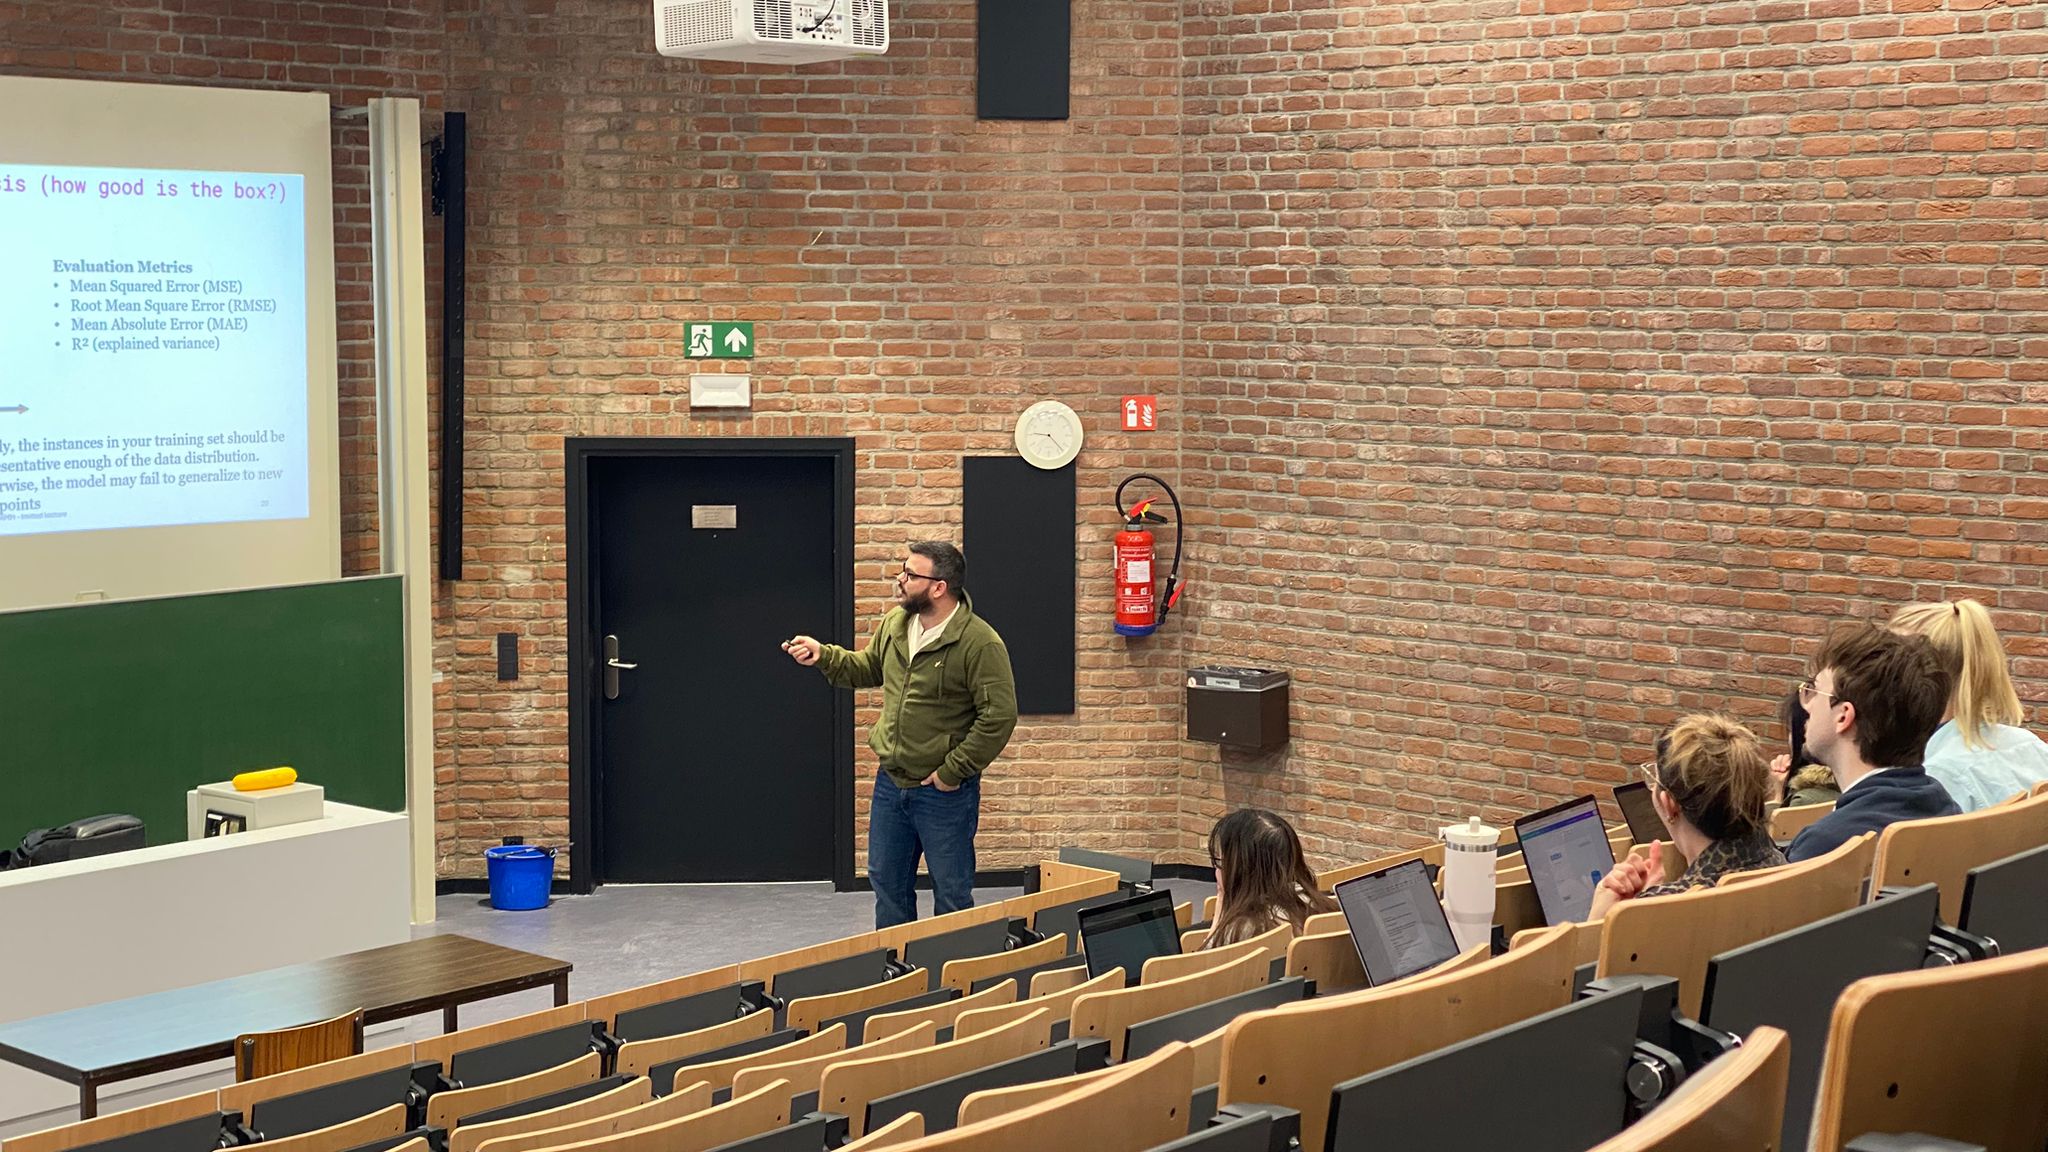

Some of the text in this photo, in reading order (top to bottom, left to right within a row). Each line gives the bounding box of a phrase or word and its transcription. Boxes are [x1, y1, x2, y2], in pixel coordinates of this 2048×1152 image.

[0, 174, 286, 203] is (how good is the box?)
[53, 259, 193, 273] Evaluation Metrics
[70, 279, 242, 295] Mean Squared Error (MSE)
[71, 299, 277, 314] Root Mean Square Error (RMSE)
[71, 317, 248, 332] Mean Absolute Error (MAE)
[92, 336, 161, 352] (explained
[163, 336, 220, 350] variance)
[18, 438, 40, 451] the
[43, 437, 104, 450] instances
[107, 435, 119, 448] in
[122, 437, 152, 450] your
[155, 433, 204, 448] training
[207, 433, 224, 444] set
[227, 430, 268, 444] should
[271, 430, 285, 442] be
[0, 450, 259, 472] sentative enough of the data distribution.
[41, 476, 63, 490] the
[66, 474, 107, 488] model
[110, 475, 137, 488] may
[140, 470, 160, 485] fail
[163, 471, 176, 485] to
[178, 468, 240, 487] generalize
[243, 469, 255, 481] to
[258, 468, 283, 480] new
[0, 497, 41, 515] points
